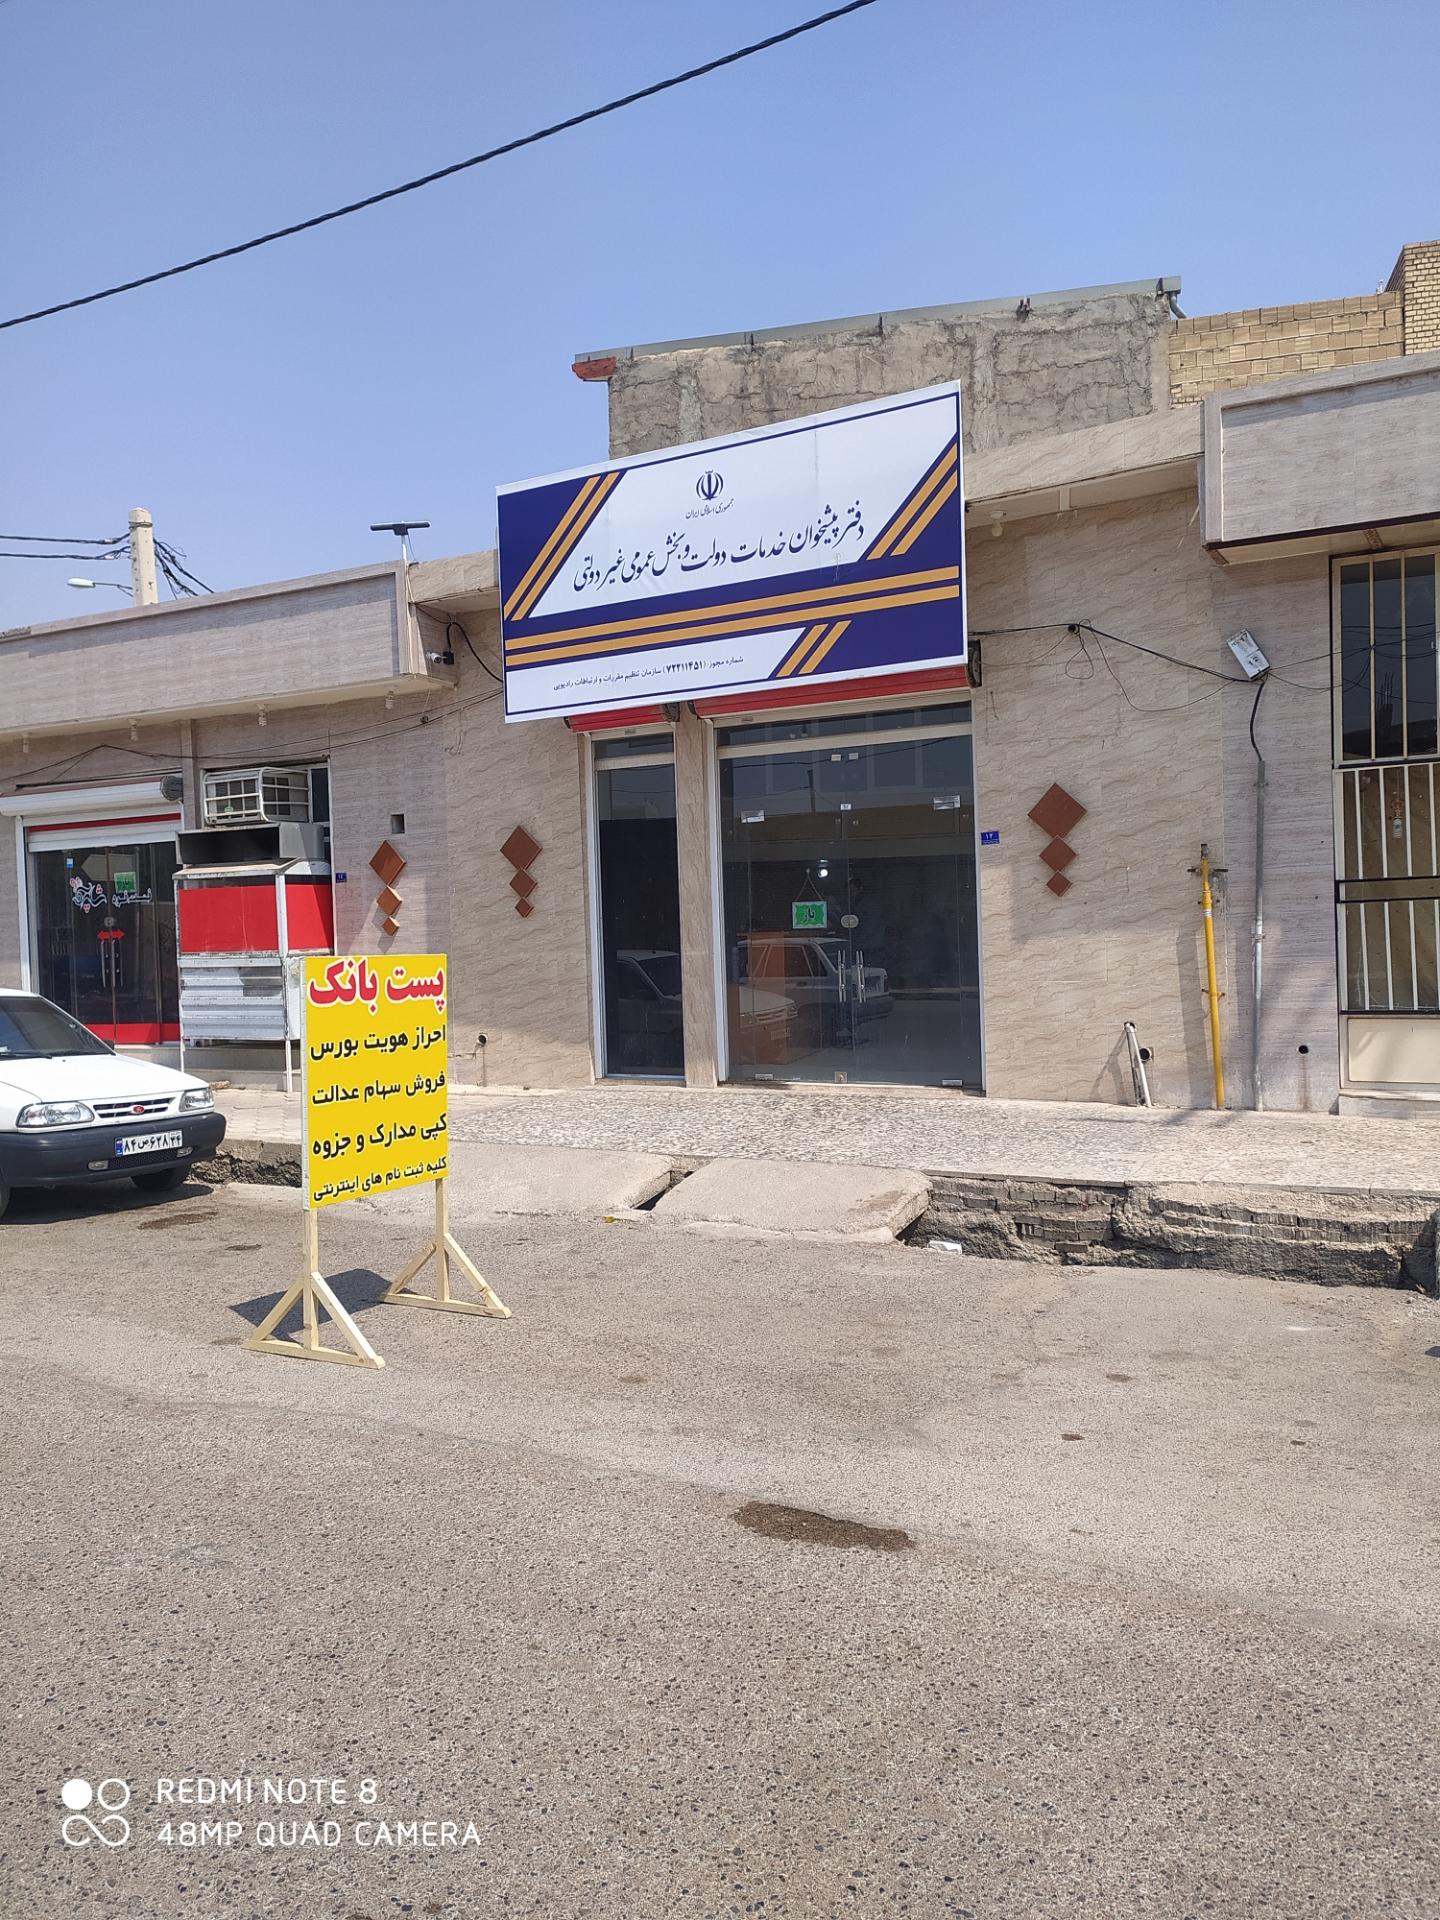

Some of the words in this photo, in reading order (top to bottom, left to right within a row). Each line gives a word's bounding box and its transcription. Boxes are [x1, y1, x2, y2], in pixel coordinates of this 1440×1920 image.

[685, 509, 700, 520] ایران
[832, 500, 864, 549] دفتر
[789, 504, 838, 553] پیشخوان
[652, 532, 686, 577] بخش
[681, 538, 727, 572] دولت
[731, 532, 787, 564] خدمات
[573, 554, 601, 592] دولتی
[597, 549, 624, 591] غیر
[621, 550, 655, 584] عمومی
[309, 959, 379, 1013] بانک
[386, 968, 446, 1013] پست
[310, 1036, 359, 1061] بورس
[364, 1032, 409, 1053] هویت
[412, 1024, 446, 1051] احراز
[312, 1084, 360, 1105] عدالت
[364, 1080, 401, 1103] سهام
[405, 1070, 446, 1097] فروش
[369, 1122, 417, 1147] مدارک
[420, 1113, 447, 1141] کپی
[312, 1132, 352, 1159] جزوه
[356, 1133, 365, 1153] و
[385, 1167, 401, 1185] نام
[403, 1161, 424, 1178] ثبت
[426, 1156, 447, 1174] کلیه
[313, 1176, 359, 1201] اینترنتی
[361, 1172, 383, 1192] های
